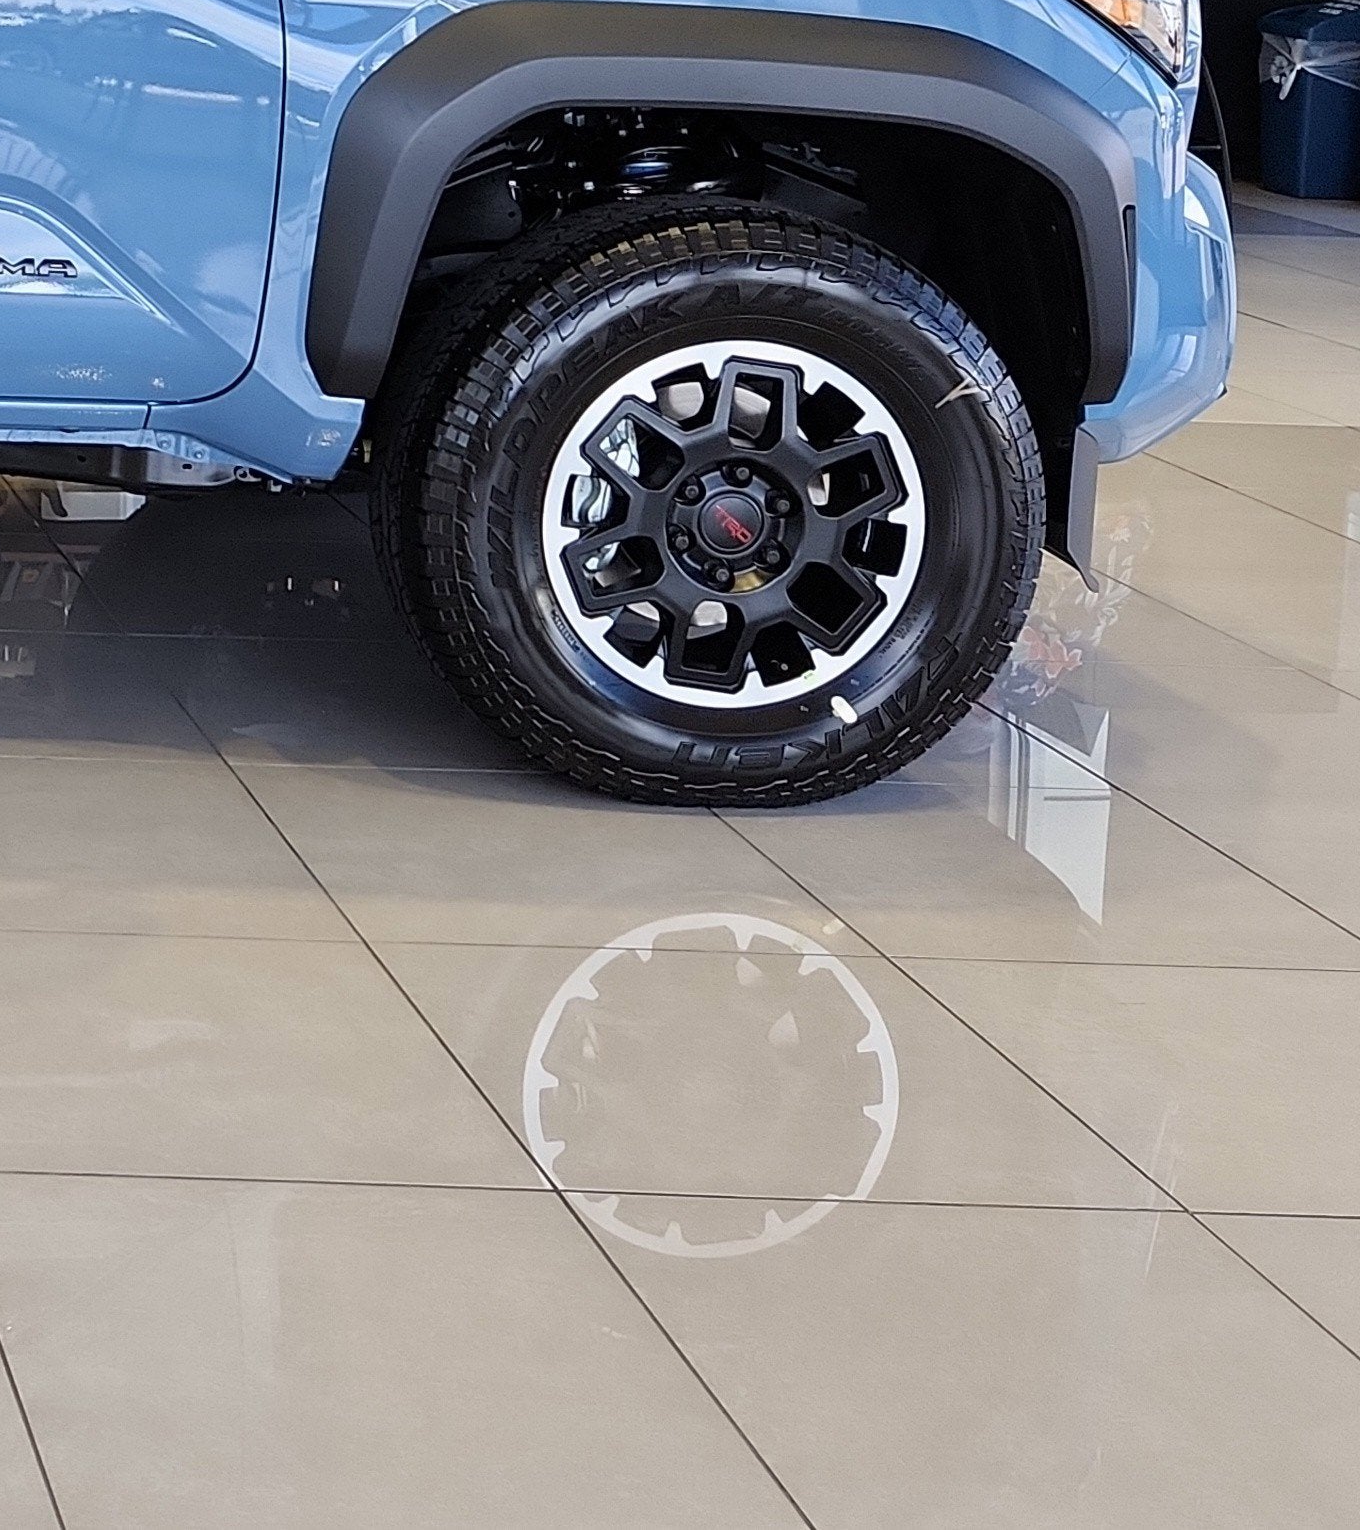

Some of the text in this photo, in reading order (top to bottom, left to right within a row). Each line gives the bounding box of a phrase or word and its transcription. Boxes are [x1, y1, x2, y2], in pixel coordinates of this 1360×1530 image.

[487, 291, 686, 589] WILDPEAK
[714, 503, 753, 545] TRD
[672, 631, 964, 771] FALKEN
